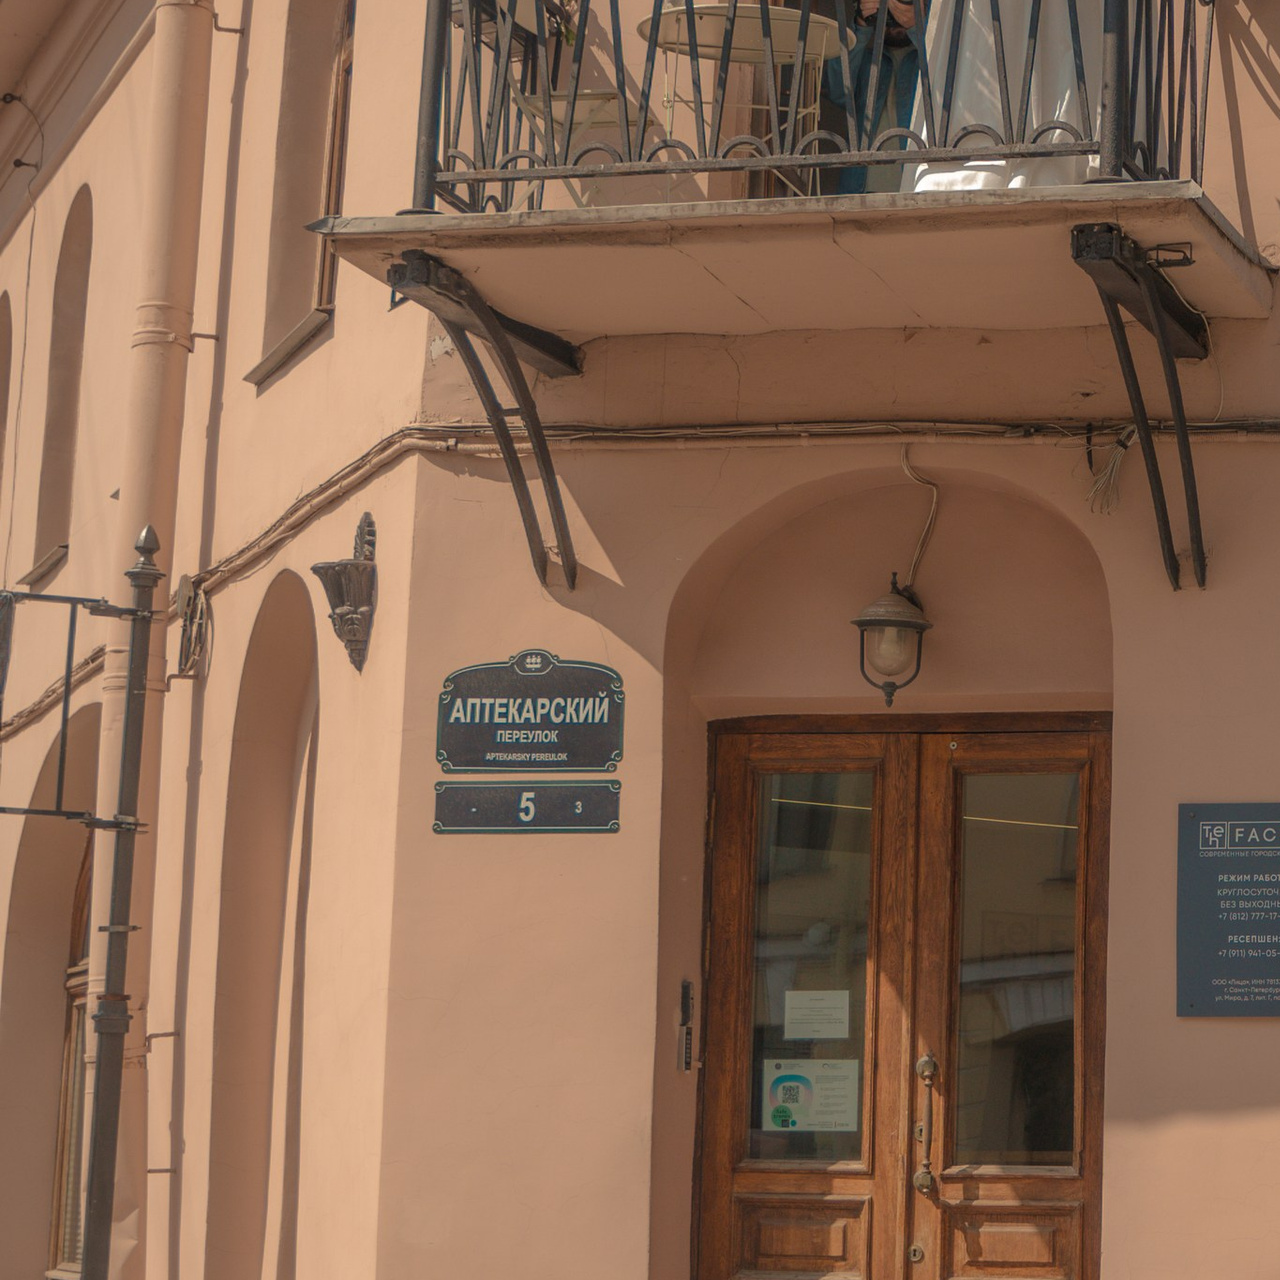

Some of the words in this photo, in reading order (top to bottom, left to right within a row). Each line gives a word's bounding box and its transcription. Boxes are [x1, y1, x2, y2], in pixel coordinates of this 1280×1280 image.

[449, 691, 610, 724] АПТЕКАРСКИЙ
[497, 730, 559, 743] ПЕРЕУЛОК
[486, 752, 530, 761] APTEKARSKY
[531, 752, 568, 761] PEREULOK
[519, 792, 535, 822] 5
[575, 801, 582, 813] 3
[1218, 874, 1251, 882] РЕЖИМ
[1220, 900, 1236, 908] БЕЗ
[1218, 912, 1227, 920] +7
[1229, 912, 1249, 921] (812)
[1228, 935, 1280, 943] РЕСЕПШЕН:
[1228, 949, 1246, 958] (911)
